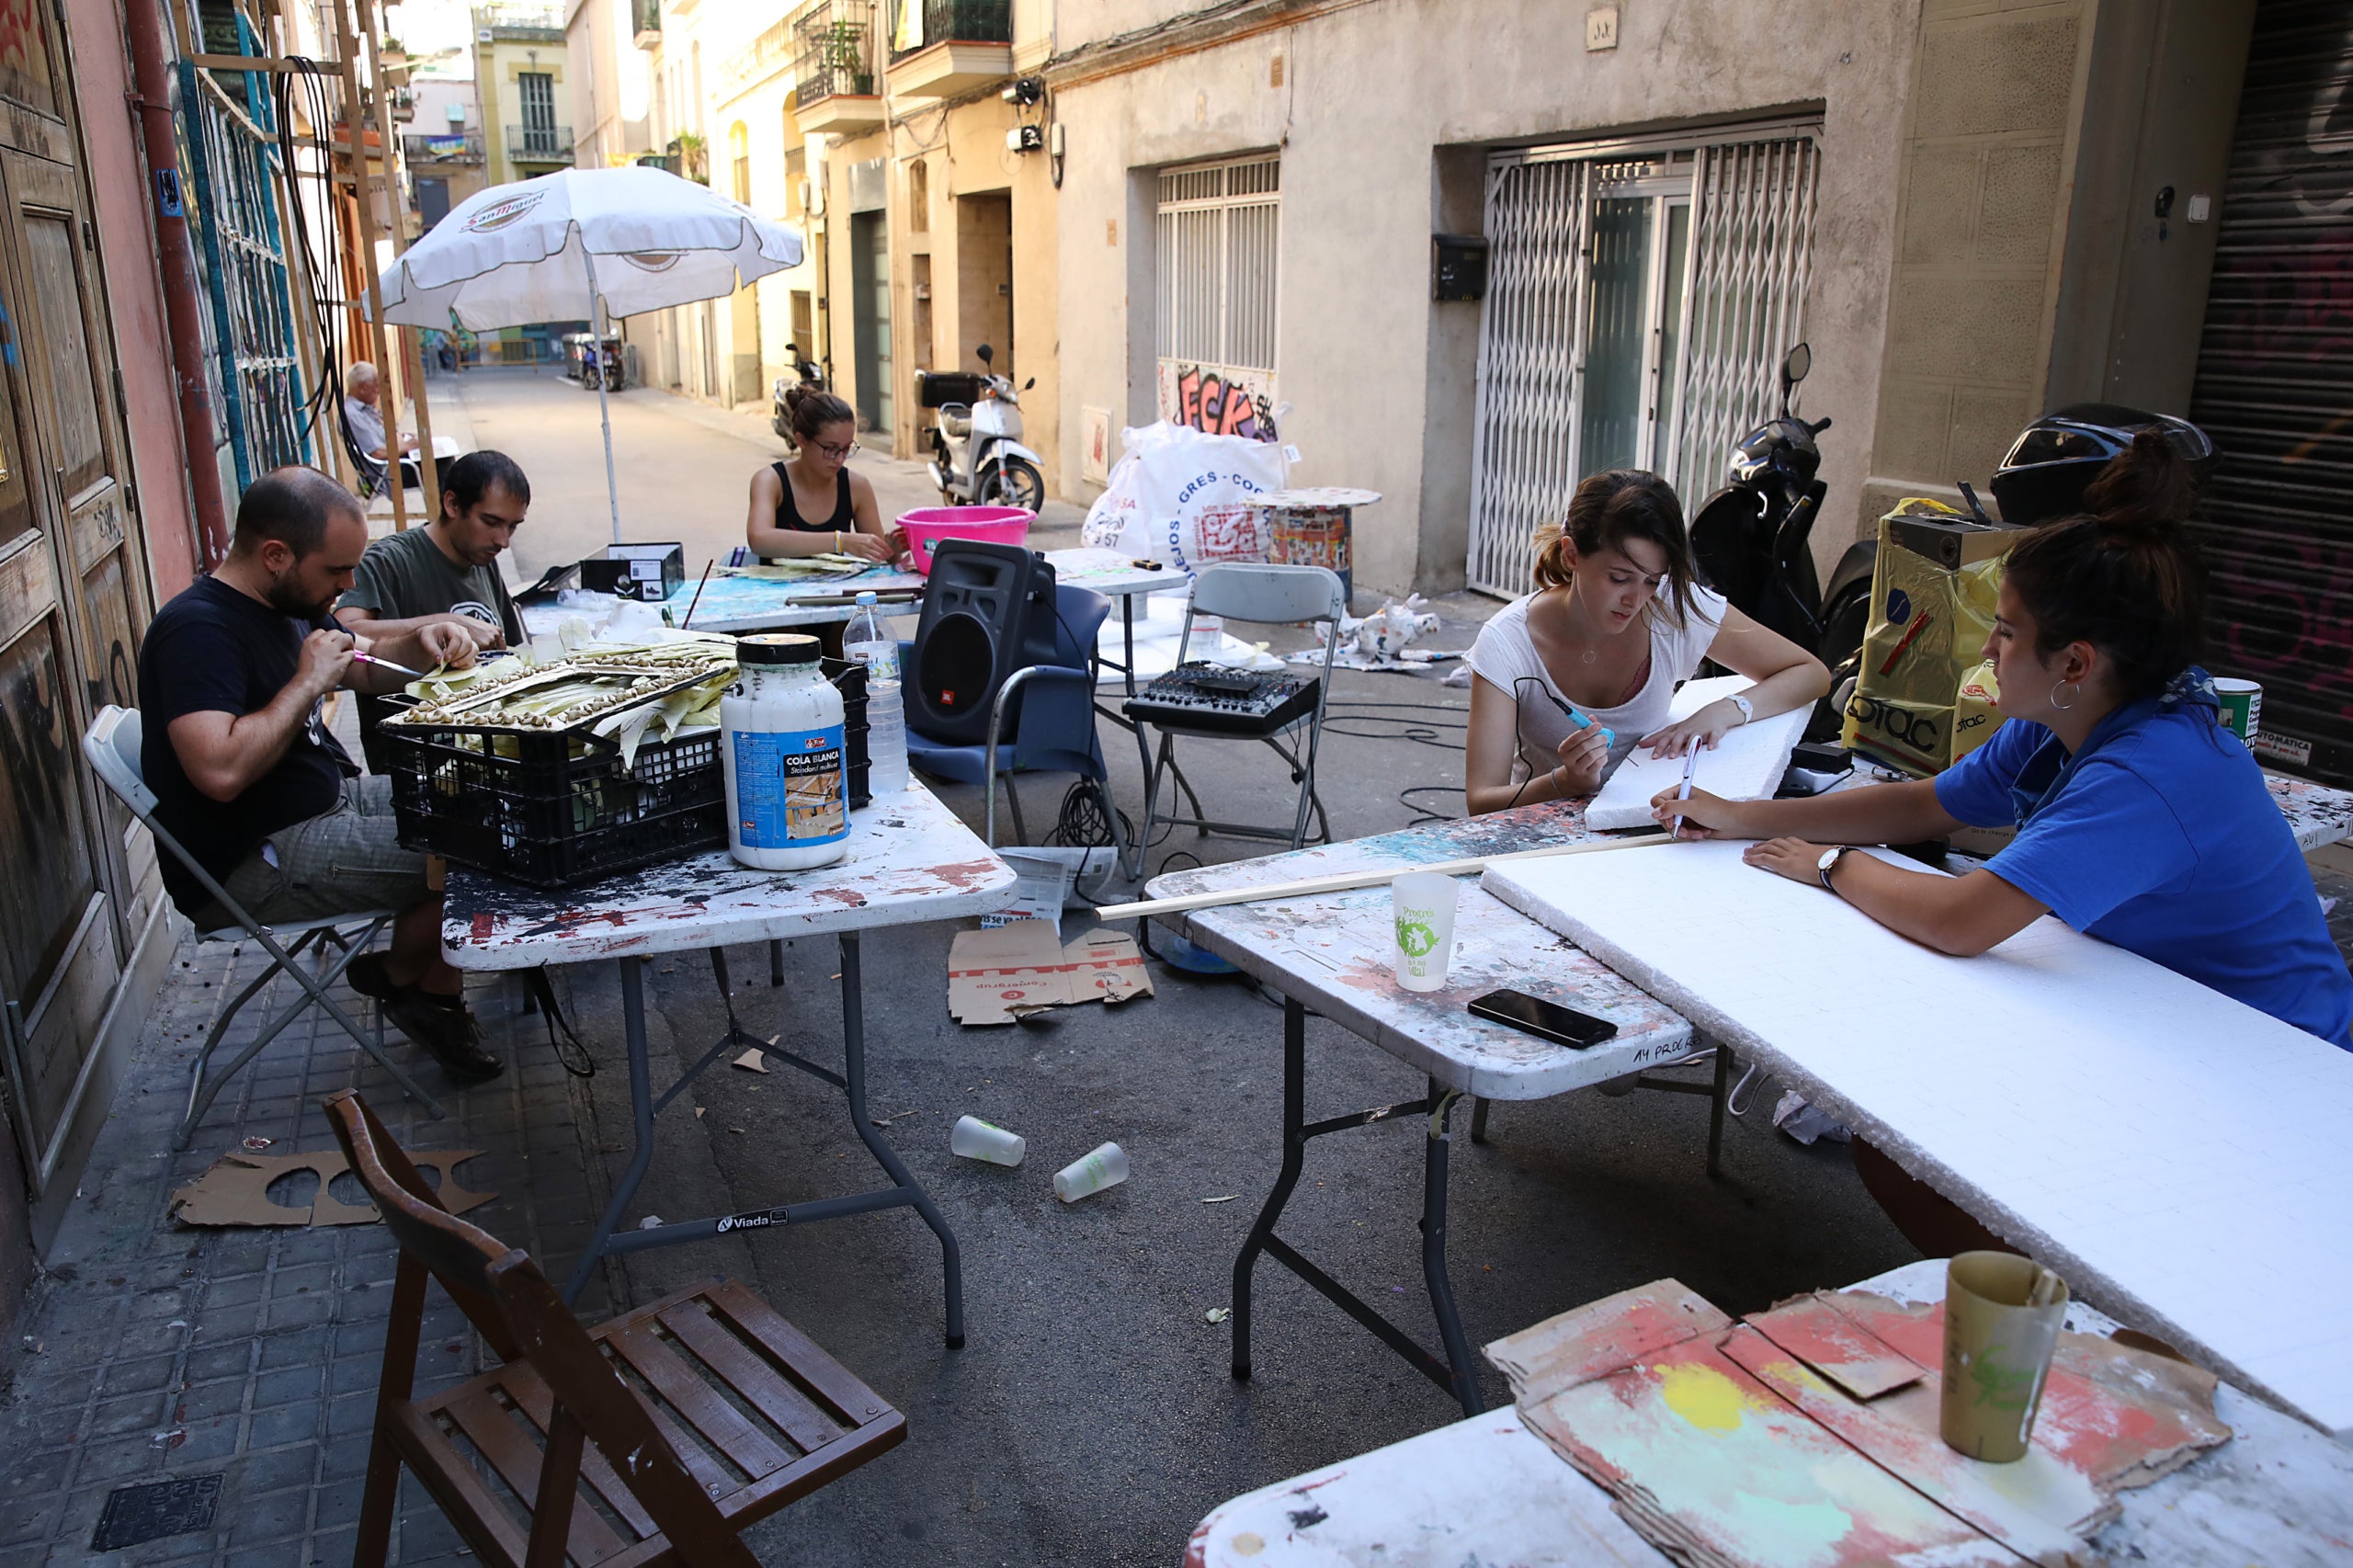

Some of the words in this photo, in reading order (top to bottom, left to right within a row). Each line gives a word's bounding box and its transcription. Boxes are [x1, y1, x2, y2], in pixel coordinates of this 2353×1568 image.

[1178, 472, 1218, 503] GRES
[786, 756, 812, 766] COLA
[813, 751, 839, 763] BLANCA
[790, 765, 820, 774] Standard
[733, 1216, 768, 1228] Viada
